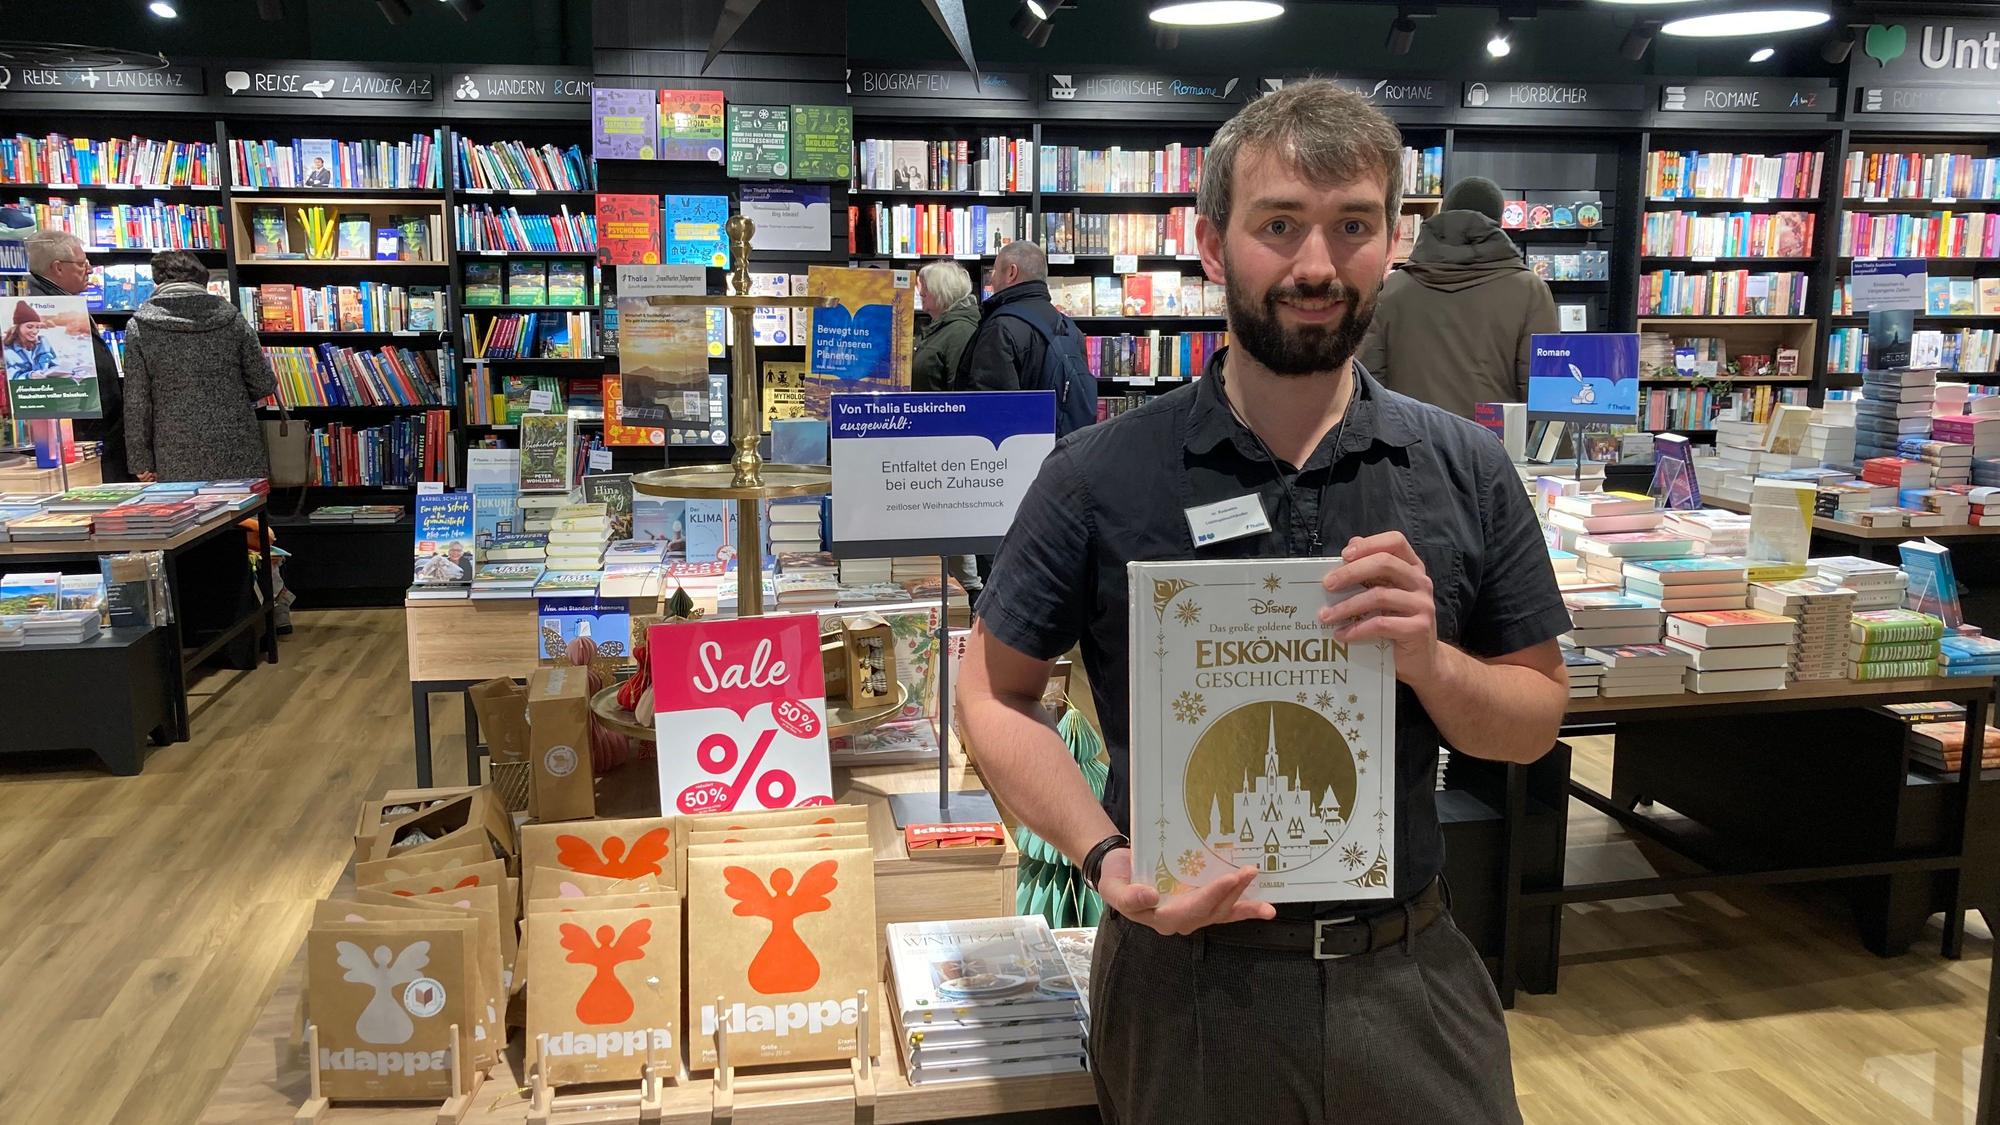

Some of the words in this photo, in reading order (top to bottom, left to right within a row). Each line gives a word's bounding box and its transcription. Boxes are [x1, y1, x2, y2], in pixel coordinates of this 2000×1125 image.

[1921, 26, 2000, 69] Unt
[23, 69, 62, 86] REISE
[166, 73, 183, 87] A-Z
[255, 73, 300, 92] REISE
[342, 75, 401, 94] LÄNDER
[407, 79, 431, 94] A-Z
[487, 79, 545, 96] WANDERN
[554, 80, 563, 95] &
[863, 72, 950, 93] BIOGRAFIEN
[1086, 77, 1164, 97] HISTORISCHE
[1169, 79, 1218, 97] Romane
[1386, 85, 1432, 100] ROMANE
[1510, 83, 1587, 104] HÖRBÜCHER
[1704, 90, 1760, 108] ROMANE
[731, 137, 785, 145] RECHTSGESCHICHTE
[817, 325, 851, 337] Bewegt
[853, 328, 869, 336] uns
[817, 337, 834, 347] und
[836, 339, 872, 349] unseren
[1536, 347, 1571, 357] Romane
[816, 350, 858, 361] Planeten.
[839, 403, 862, 415] Von
[865, 403, 900, 414] Thalia
[903, 402, 966, 413] Euskirchen
[840, 416, 912, 438] ausgewählt:
[882, 460, 937, 473] Entfaltet
[941, 459, 966, 472] den
[970, 458, 1008, 473] Engel
[594, 486, 613, 495] Hin
[886, 478, 906, 491] bei
[910, 477, 942, 490] euch
[947, 476, 1004, 489] Zuhause
[603, 494, 625, 512] weg
[886, 503, 920, 511] zeitloser
[923, 499, 1004, 510] Weihnachtsschmuck
[690, 513, 722, 523] KLIMA
[1248, 598, 1298, 619] Disney
[929, 607, 938, 633] TOPP
[1209, 624, 1226, 633] Das
[1228, 623, 1251, 634] große
[1257, 622, 1292, 634] goldene
[1295, 621, 1318, 630] Buch
[957, 636, 967, 660] TOPP
[1195, 636, 1349, 669] EISKÖNIGIN
[692, 638, 791, 693] Sale
[1195, 668, 1348, 689] GESCHICHTEN
[778, 701, 816, 732] 50%
[684, 787, 728, 808] 50%
[701, 997, 858, 1037] klappa
[543, 1029, 672, 1058] klappa
[319, 1047, 451, 1077] klappa
